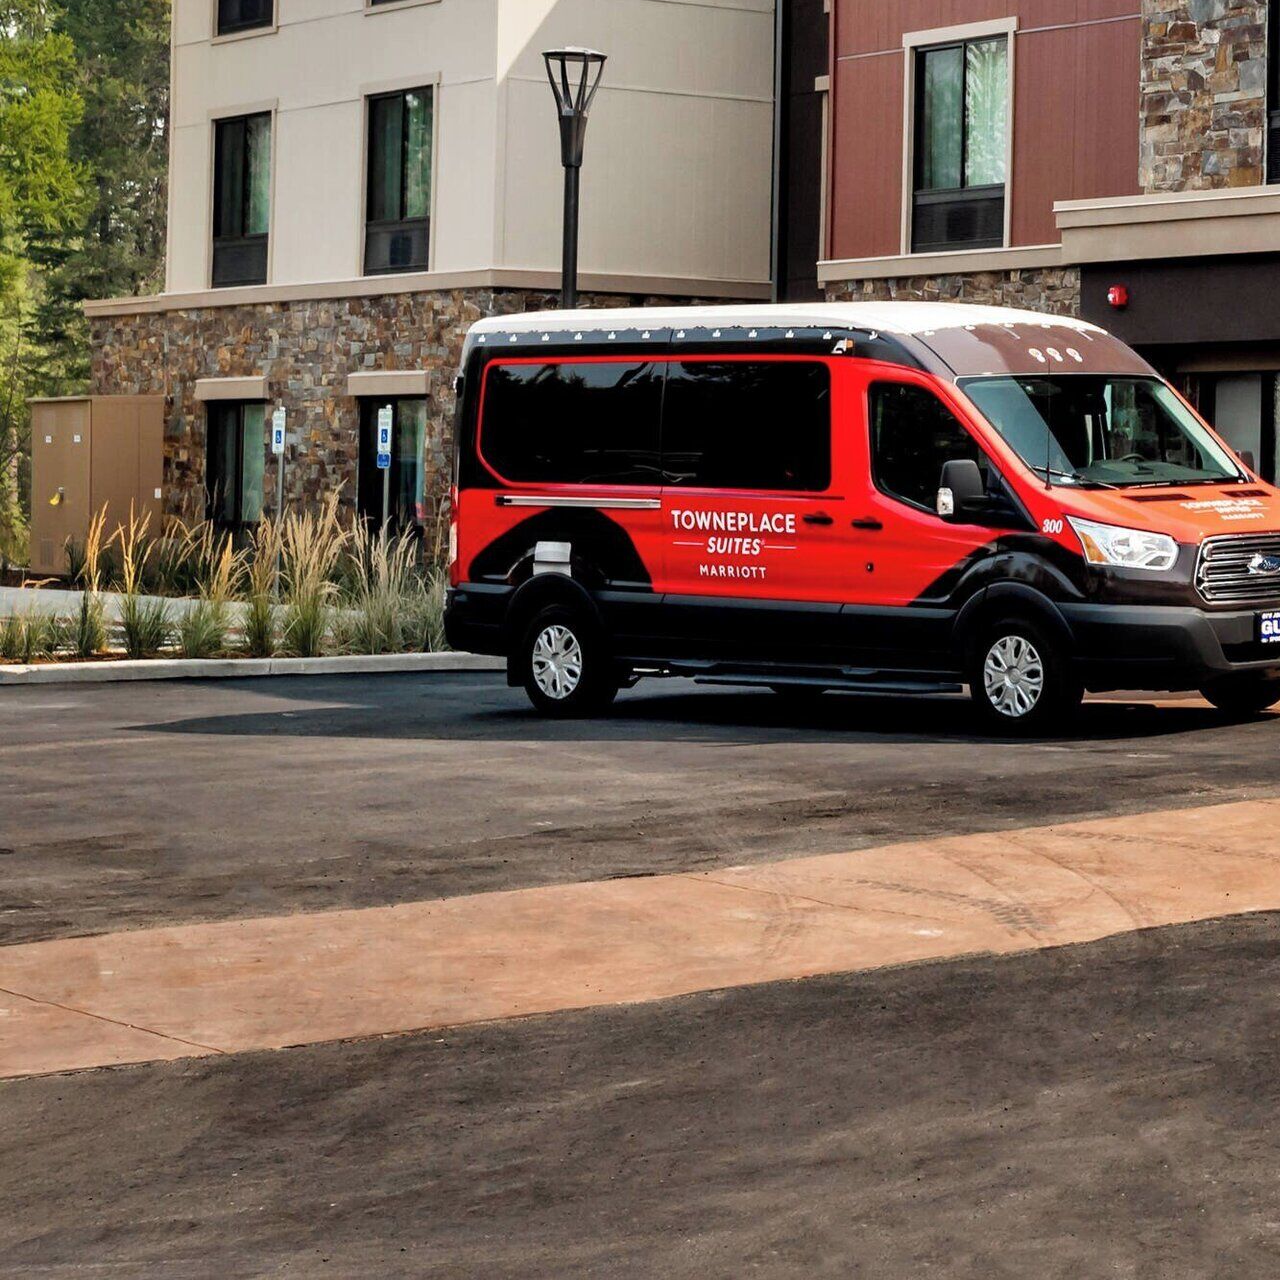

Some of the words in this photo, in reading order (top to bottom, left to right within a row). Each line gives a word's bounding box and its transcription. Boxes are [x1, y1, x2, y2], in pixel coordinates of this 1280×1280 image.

[671, 509, 796, 533] TOWNEPLACE
[1042, 518, 1064, 534] 300
[699, 564, 767, 579] MARRIOTT
